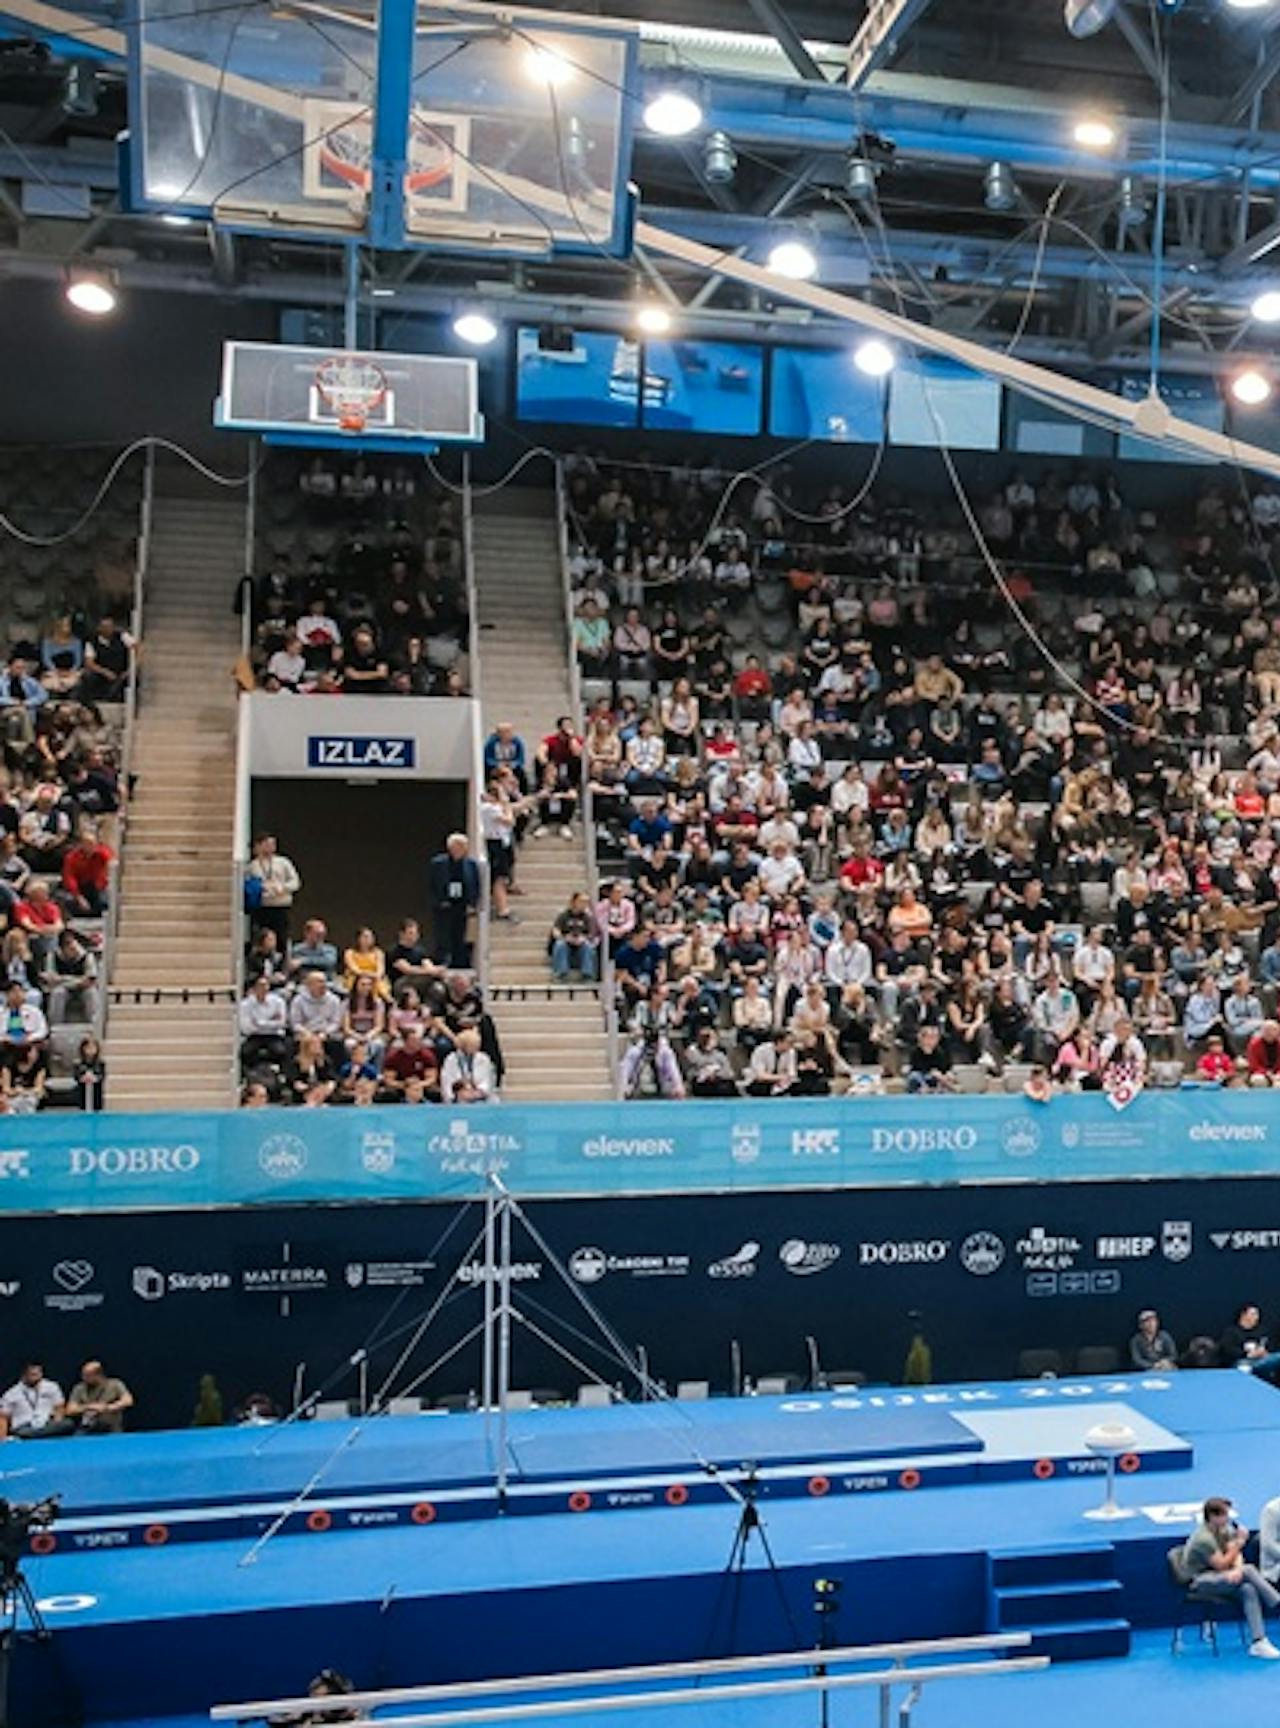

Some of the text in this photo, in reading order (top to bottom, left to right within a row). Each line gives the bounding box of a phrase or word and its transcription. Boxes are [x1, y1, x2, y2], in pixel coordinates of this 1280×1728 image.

[318, 741, 405, 765] IZLAZ
[871, 1125, 978, 1152] DOBRO
[69, 1144, 200, 1176] DOBRO
[859, 1239, 946, 1264] DOBRO
[168, 1272, 231, 1292] Skripta
